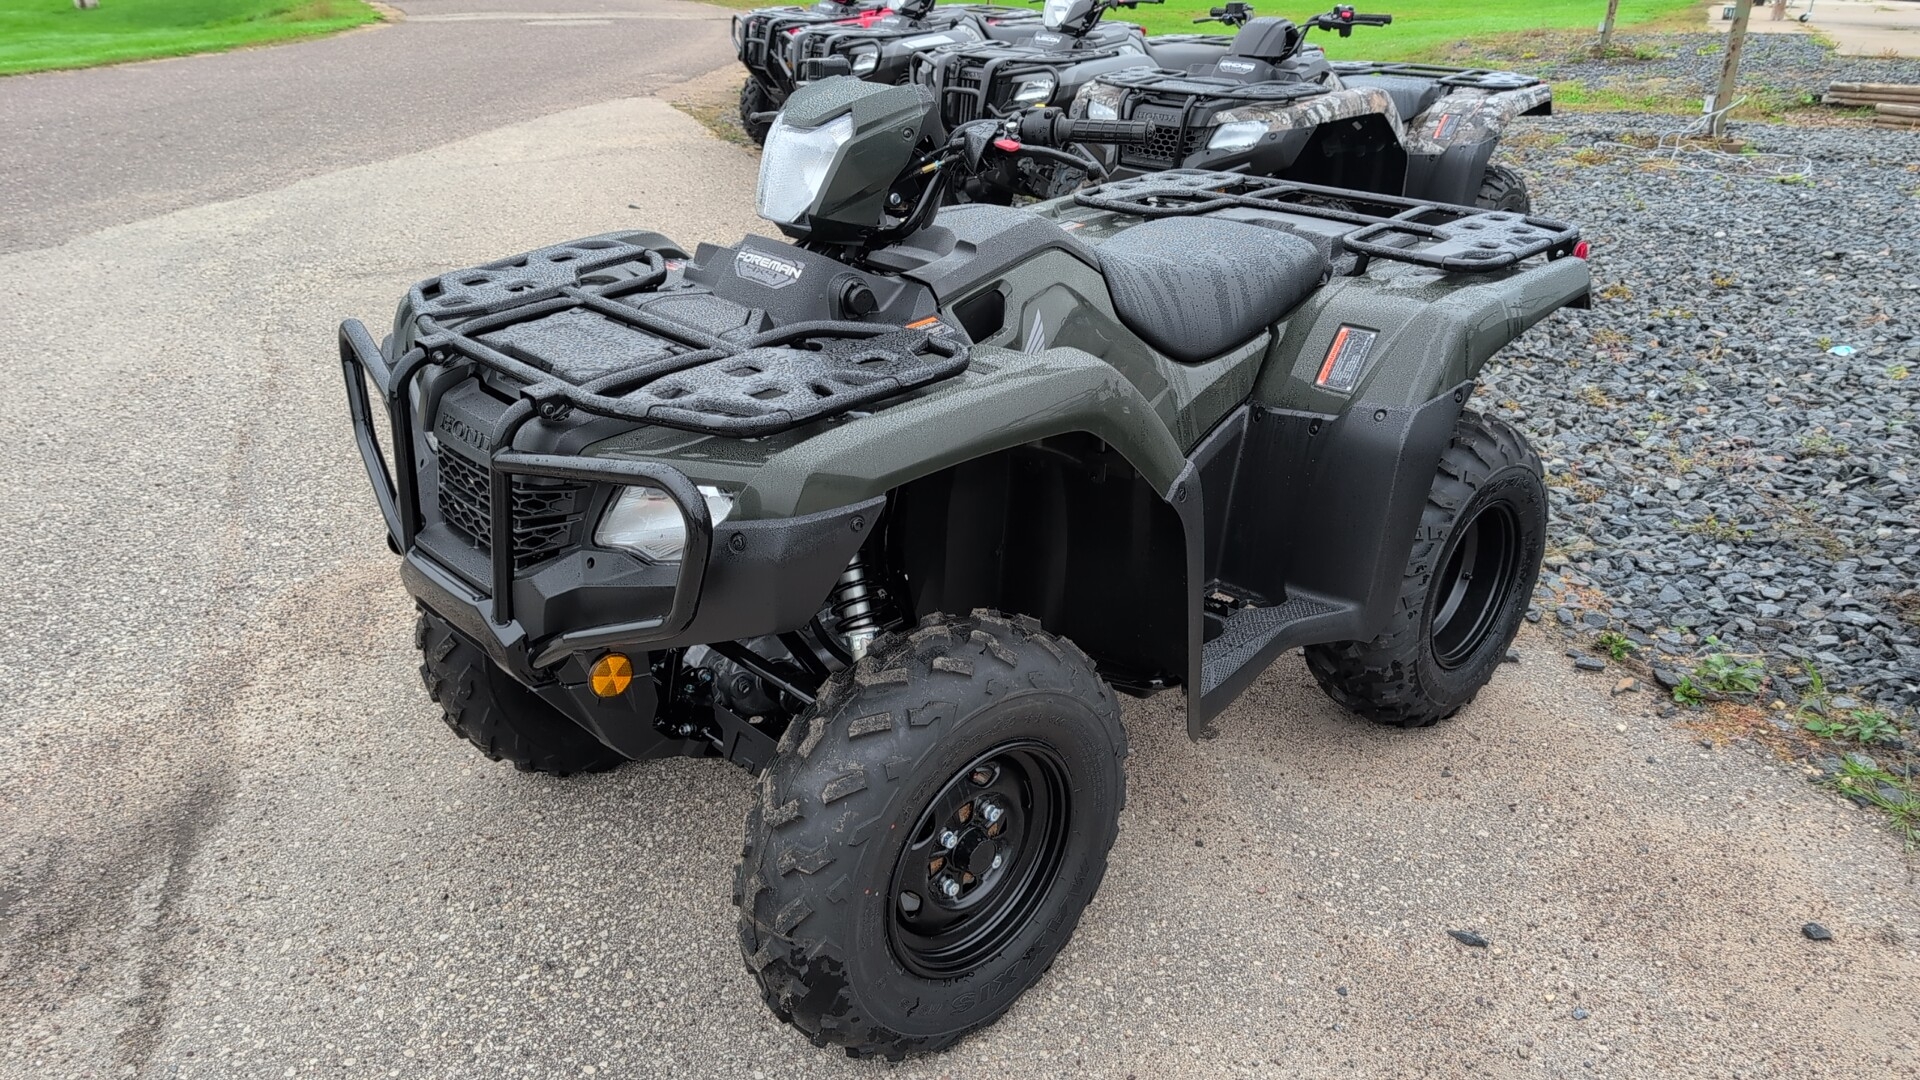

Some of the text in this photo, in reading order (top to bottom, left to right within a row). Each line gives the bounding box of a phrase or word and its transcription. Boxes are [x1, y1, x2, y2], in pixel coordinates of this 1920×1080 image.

[1137, 110, 1177, 123] HONDA
[736, 251, 803, 279] FOREMAN
[439, 411, 491, 453] HOND
[950, 857, 1090, 1016] MAXXIS
